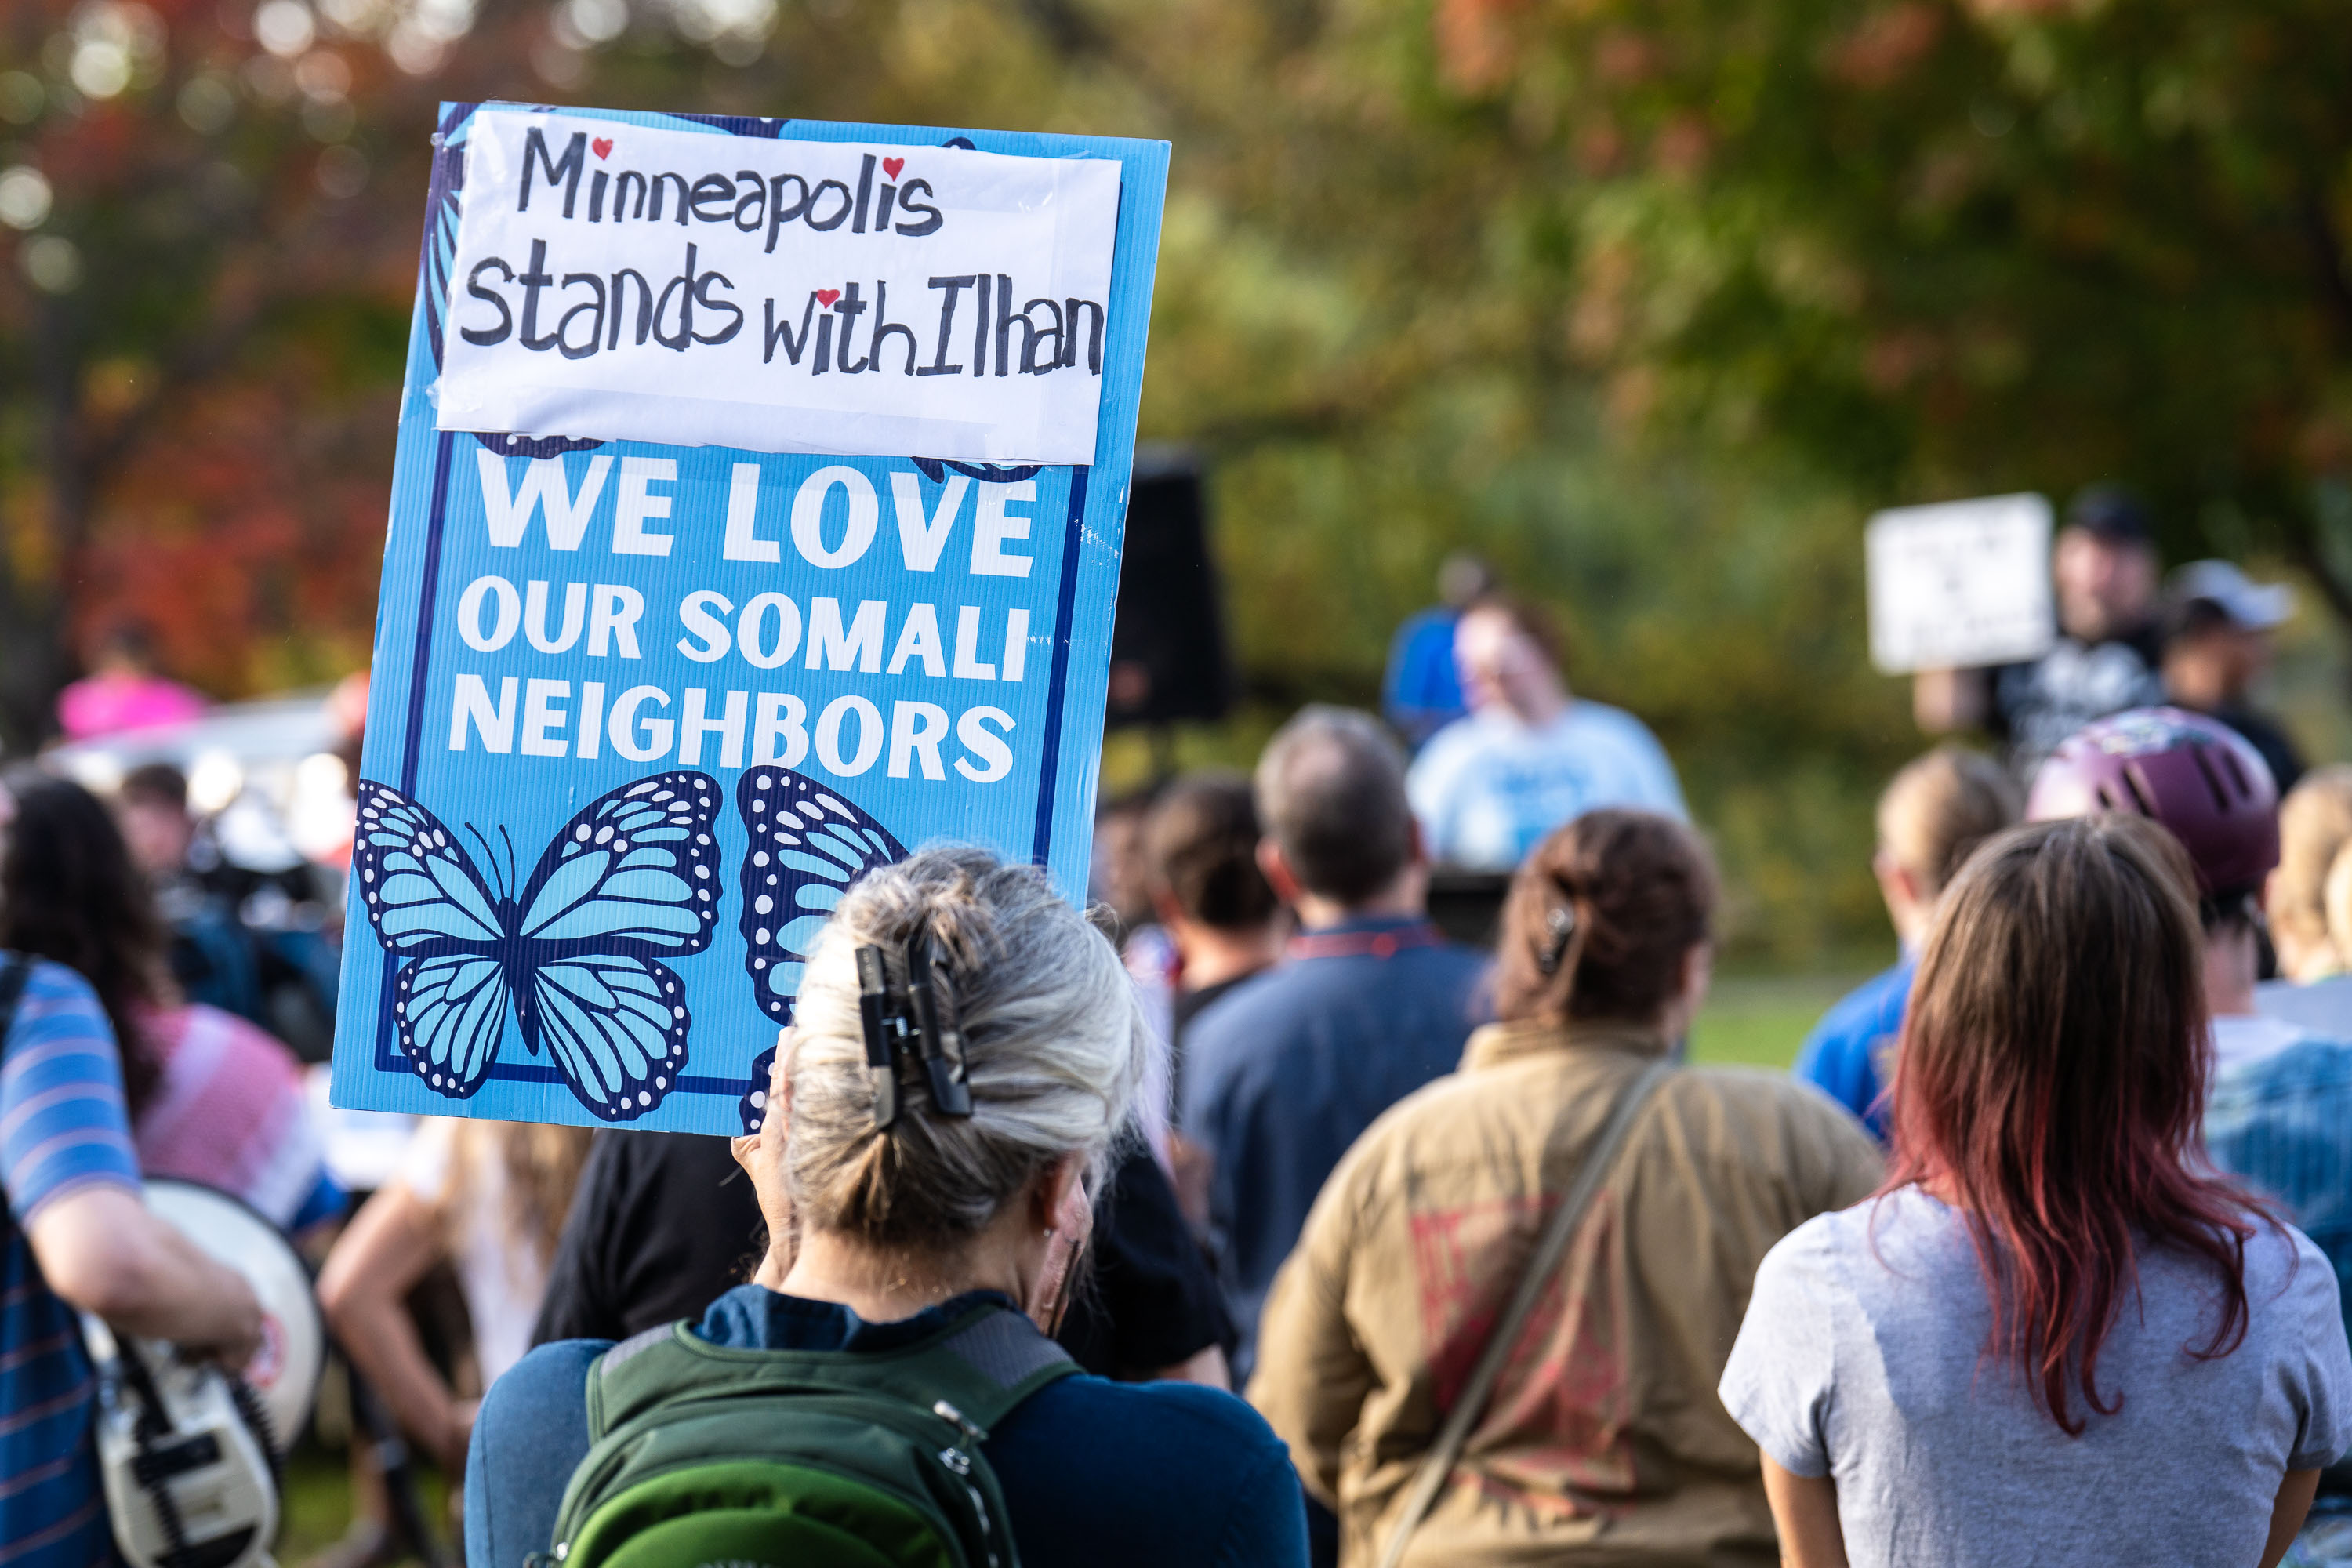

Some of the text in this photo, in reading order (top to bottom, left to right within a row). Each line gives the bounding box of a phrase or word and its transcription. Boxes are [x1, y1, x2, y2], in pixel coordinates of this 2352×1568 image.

[517, 126, 944, 254] Minneapolis
[764, 280, 917, 376] with
[916, 273, 1104, 377] Ilhan
[476, 448, 1037, 578] WE LOVE
[456, 575, 1030, 682] OUR SOMALI
[448, 673, 1017, 783] NEIGHBORS
